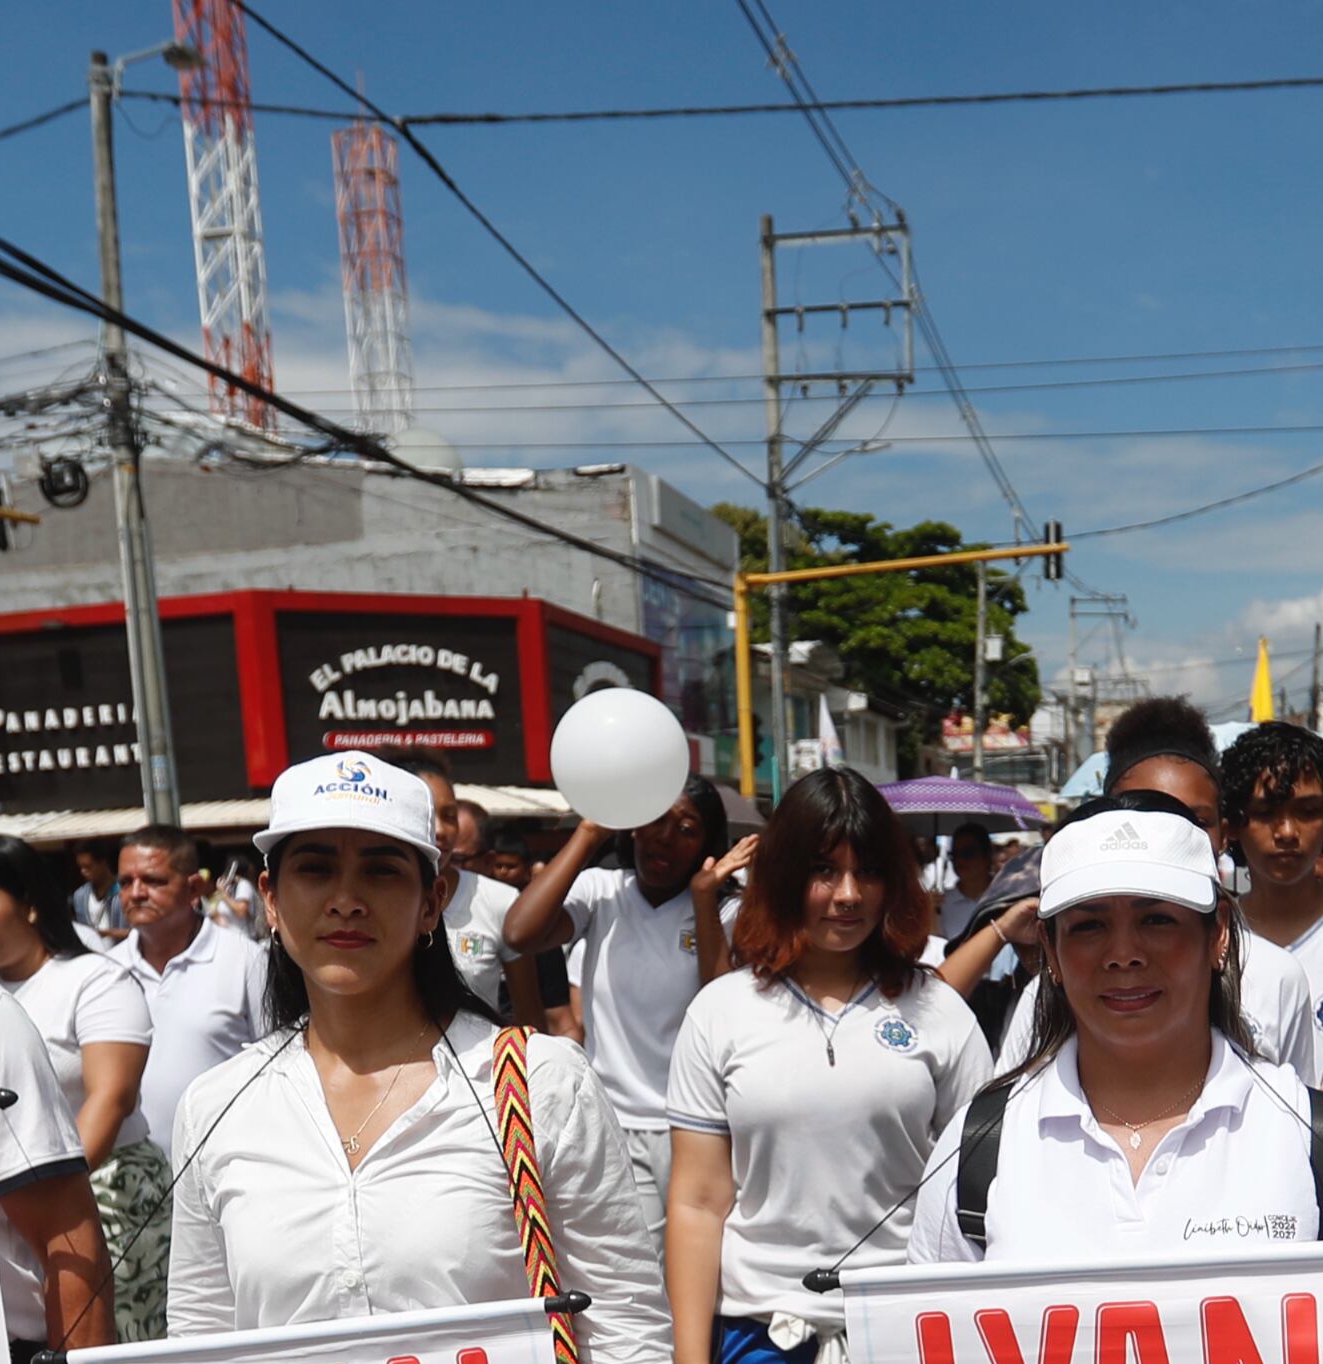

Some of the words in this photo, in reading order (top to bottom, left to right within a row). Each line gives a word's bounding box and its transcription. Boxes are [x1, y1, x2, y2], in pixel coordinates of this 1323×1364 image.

[309, 664, 342, 693] EL
[340, 644, 435, 675] PALACIO
[436, 649, 469, 675] DE
[469, 661, 500, 695] LA
[1099, 839, 1149, 852] adidas
